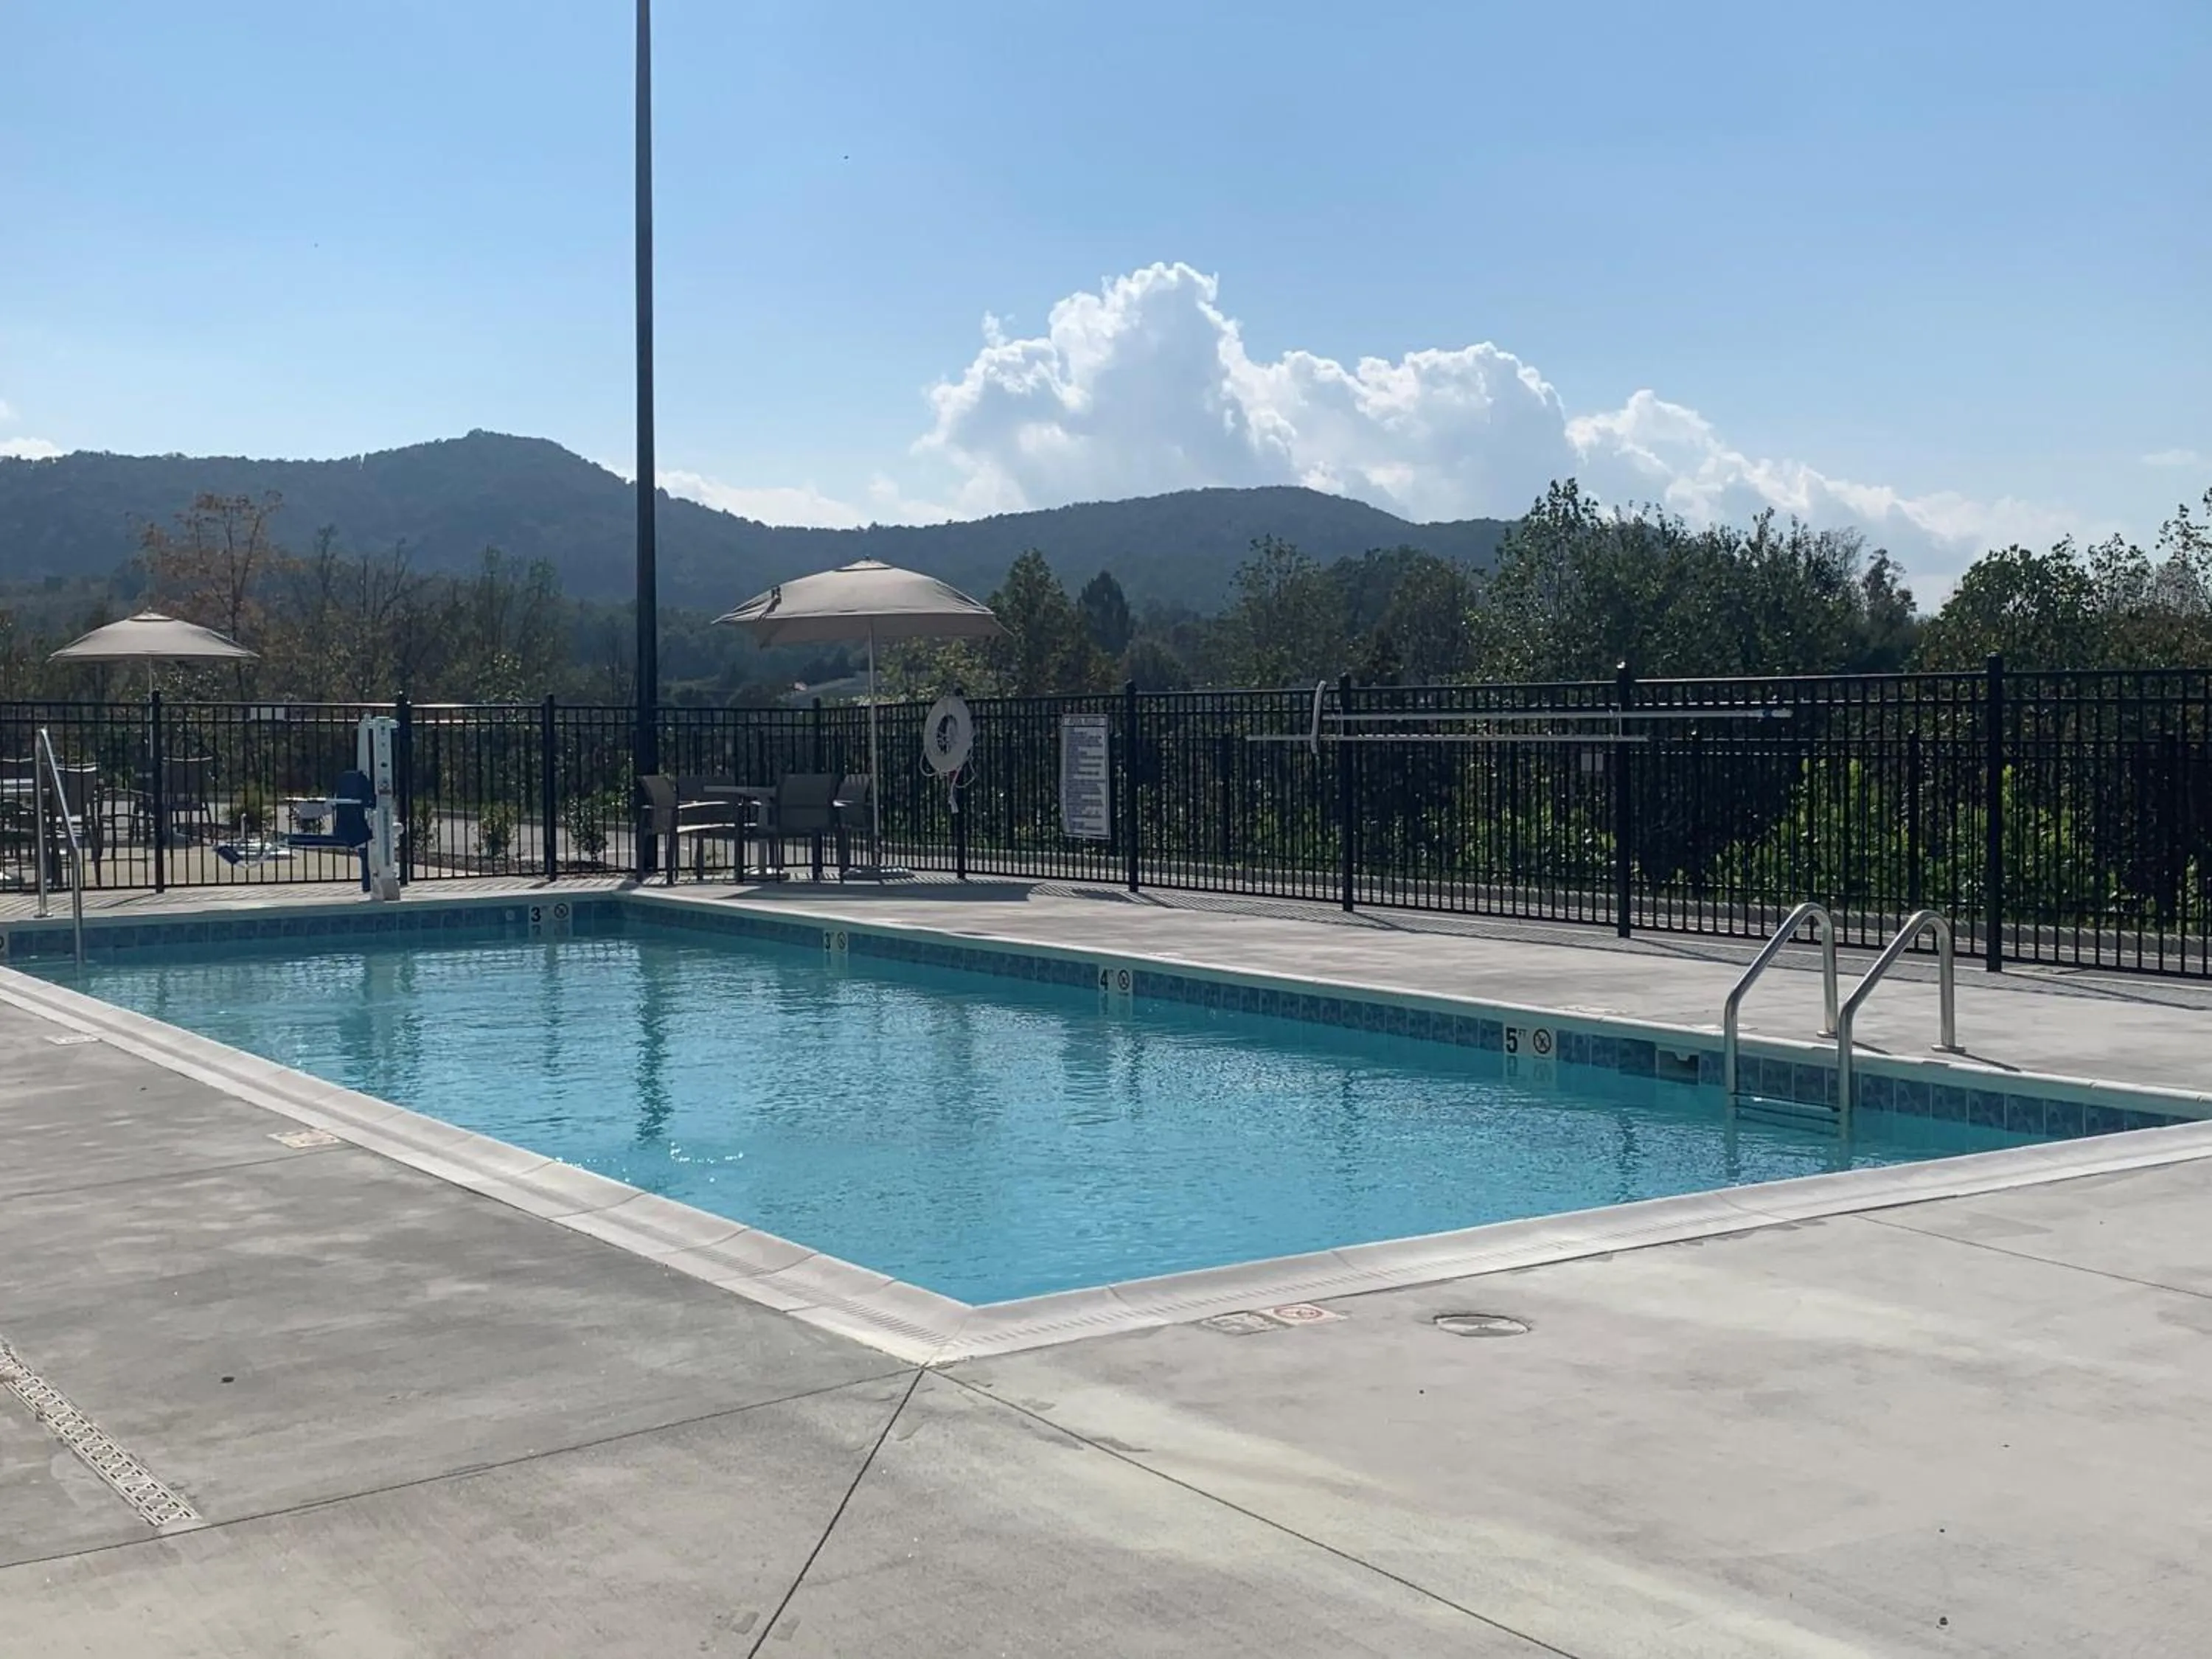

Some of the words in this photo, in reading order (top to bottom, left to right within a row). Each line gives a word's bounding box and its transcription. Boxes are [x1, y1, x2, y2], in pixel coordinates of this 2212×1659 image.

[531, 906, 541, 922] 3
[1100, 968, 1109, 991] 4
[1506, 1026, 1518, 1054] 5
